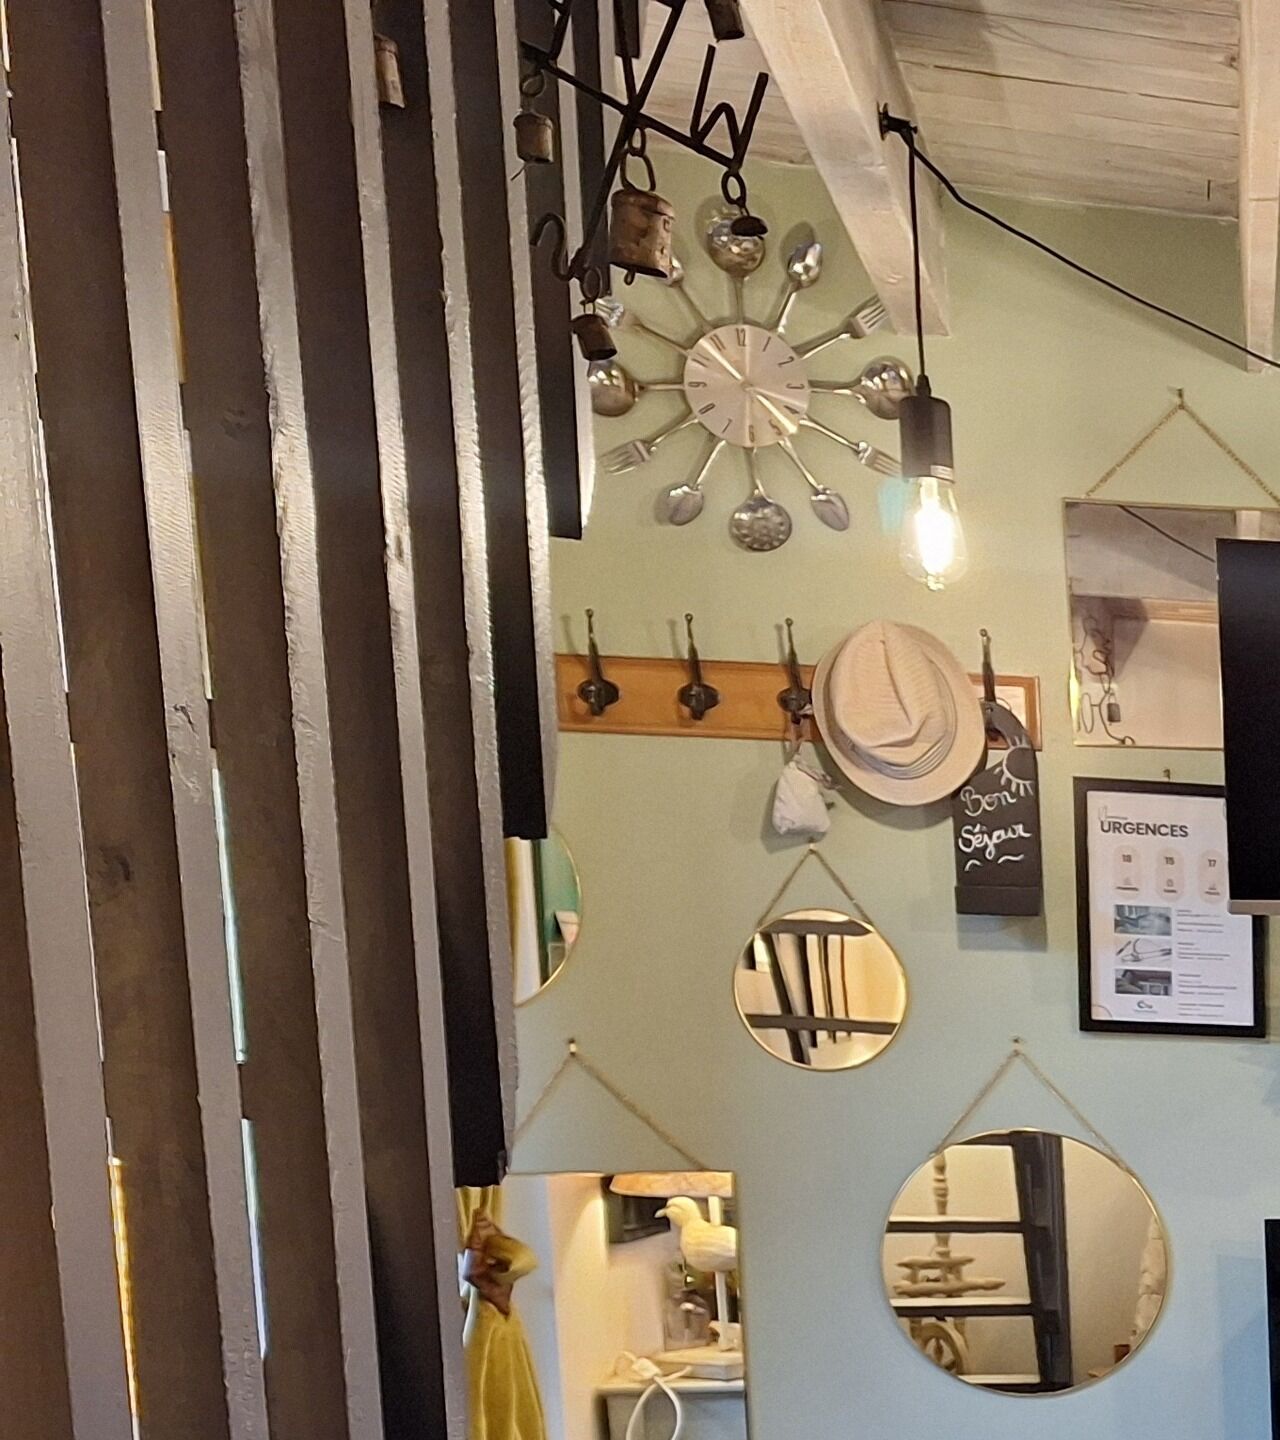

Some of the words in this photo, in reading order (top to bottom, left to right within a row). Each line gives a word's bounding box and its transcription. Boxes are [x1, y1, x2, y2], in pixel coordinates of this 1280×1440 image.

[736, 327, 746, 347] 12
[763, 336, 771, 352] 1
[778, 355, 794, 368] 2
[722, 418, 732, 434] 7
[960, 786, 1017, 817] Bon
[1100, 820, 1189, 838] URGENCES
[958, 823, 1033, 860] Séjour
[1208, 859, 1217, 868] 17
